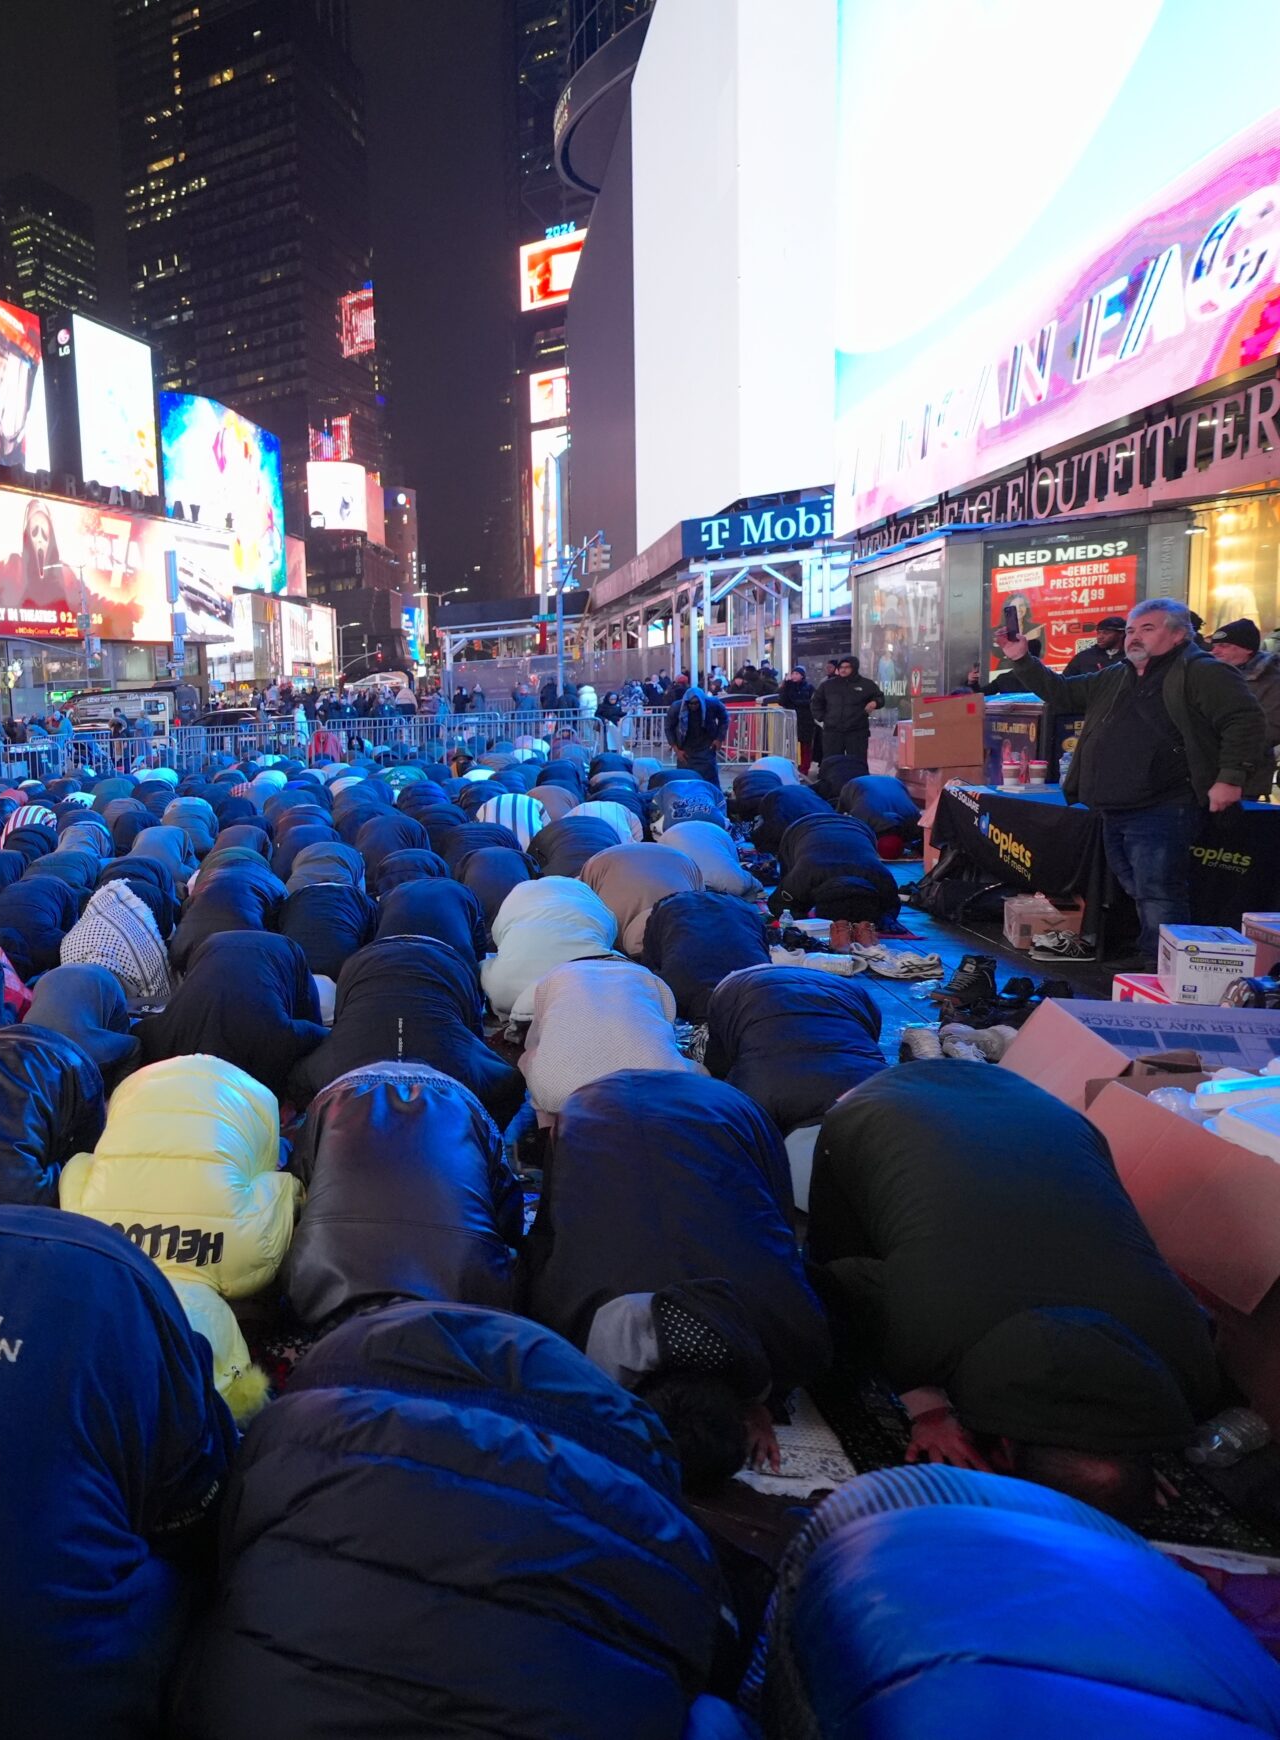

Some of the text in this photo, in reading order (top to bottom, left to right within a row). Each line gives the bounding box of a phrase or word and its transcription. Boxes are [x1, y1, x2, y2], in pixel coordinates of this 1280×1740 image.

[545, 221, 576, 239] 2026
[58, 345, 71, 357] LG
[943, 475, 1024, 525] EAGLE
[1031, 377, 1280, 519] OUTFITTER
[740, 503, 833, 546] Mobi
[998, 541, 1128, 567] NEED MEDS?
[1067, 563, 1110, 577] GENERIC
[1050, 573, 1127, 590] PRESCRIPTIONS
[7, 608, 19, 622] IN
[883, 680, 908, 697] FAMILY
[958, 791, 980, 814] SQUARE
[979, 812, 1032, 868] droplets
[1189, 846, 1252, 867] roplets
[1003, 854, 1032, 881] of mercy
[1189, 964, 1244, 973] CUTLERY KITS
[1078, 1015, 1134, 1028] STACK
[1139, 1019, 1165, 1030] TO
[1169, 1021, 1208, 1032] WAY
[1210, 1024, 1280, 1036] BETTER
[111, 1222, 224, 1268] HELLO
